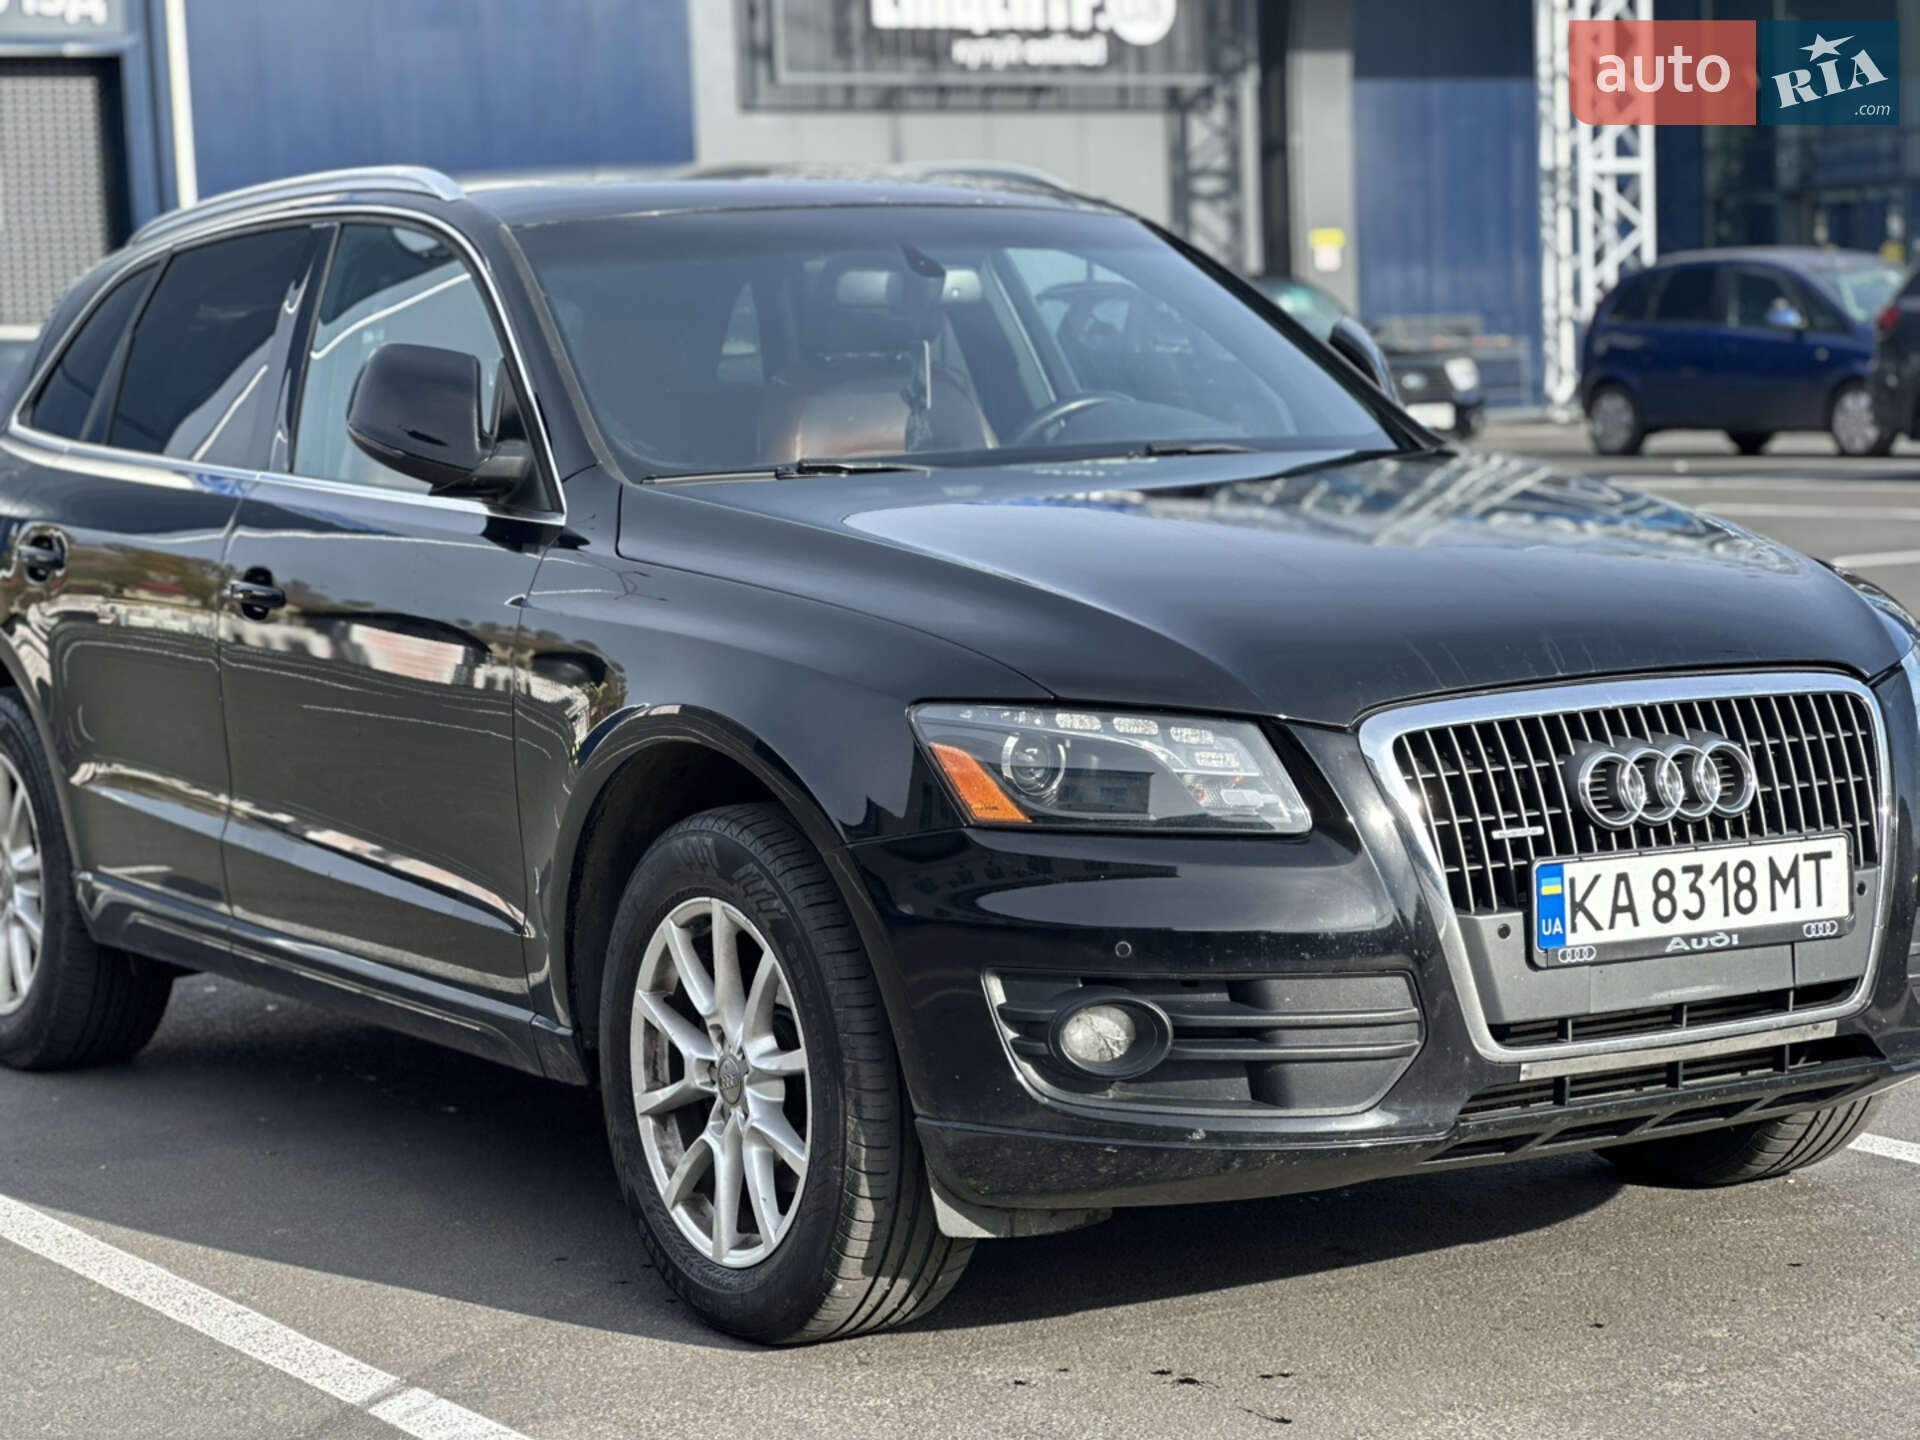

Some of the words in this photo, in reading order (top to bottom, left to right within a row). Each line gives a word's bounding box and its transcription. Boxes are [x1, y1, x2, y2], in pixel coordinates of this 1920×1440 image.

[1569, 872, 1640, 934] KA
[1651, 859, 1757, 924] 8318
[1768, 851, 1833, 912] MT
[1541, 917, 1565, 937] UA
[1665, 933, 1739, 953] Audi
